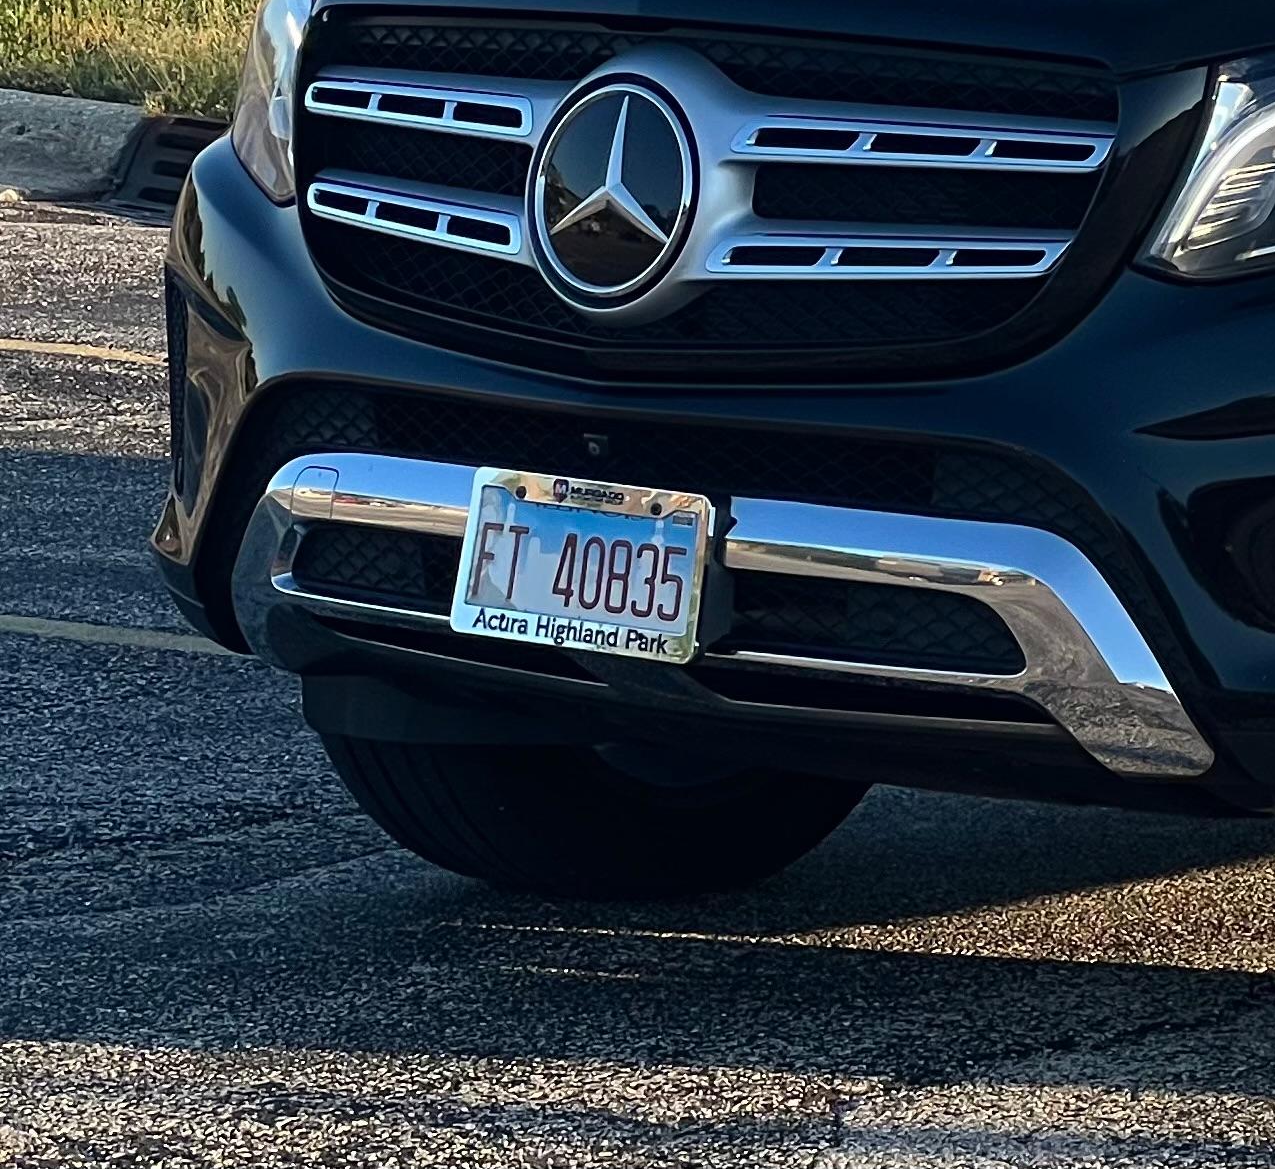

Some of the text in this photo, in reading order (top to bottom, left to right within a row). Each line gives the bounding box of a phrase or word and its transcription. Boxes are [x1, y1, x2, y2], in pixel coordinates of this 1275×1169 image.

[470, 522, 687, 621] FT 40835
[472, 607, 668, 655] Acura Highland Park
